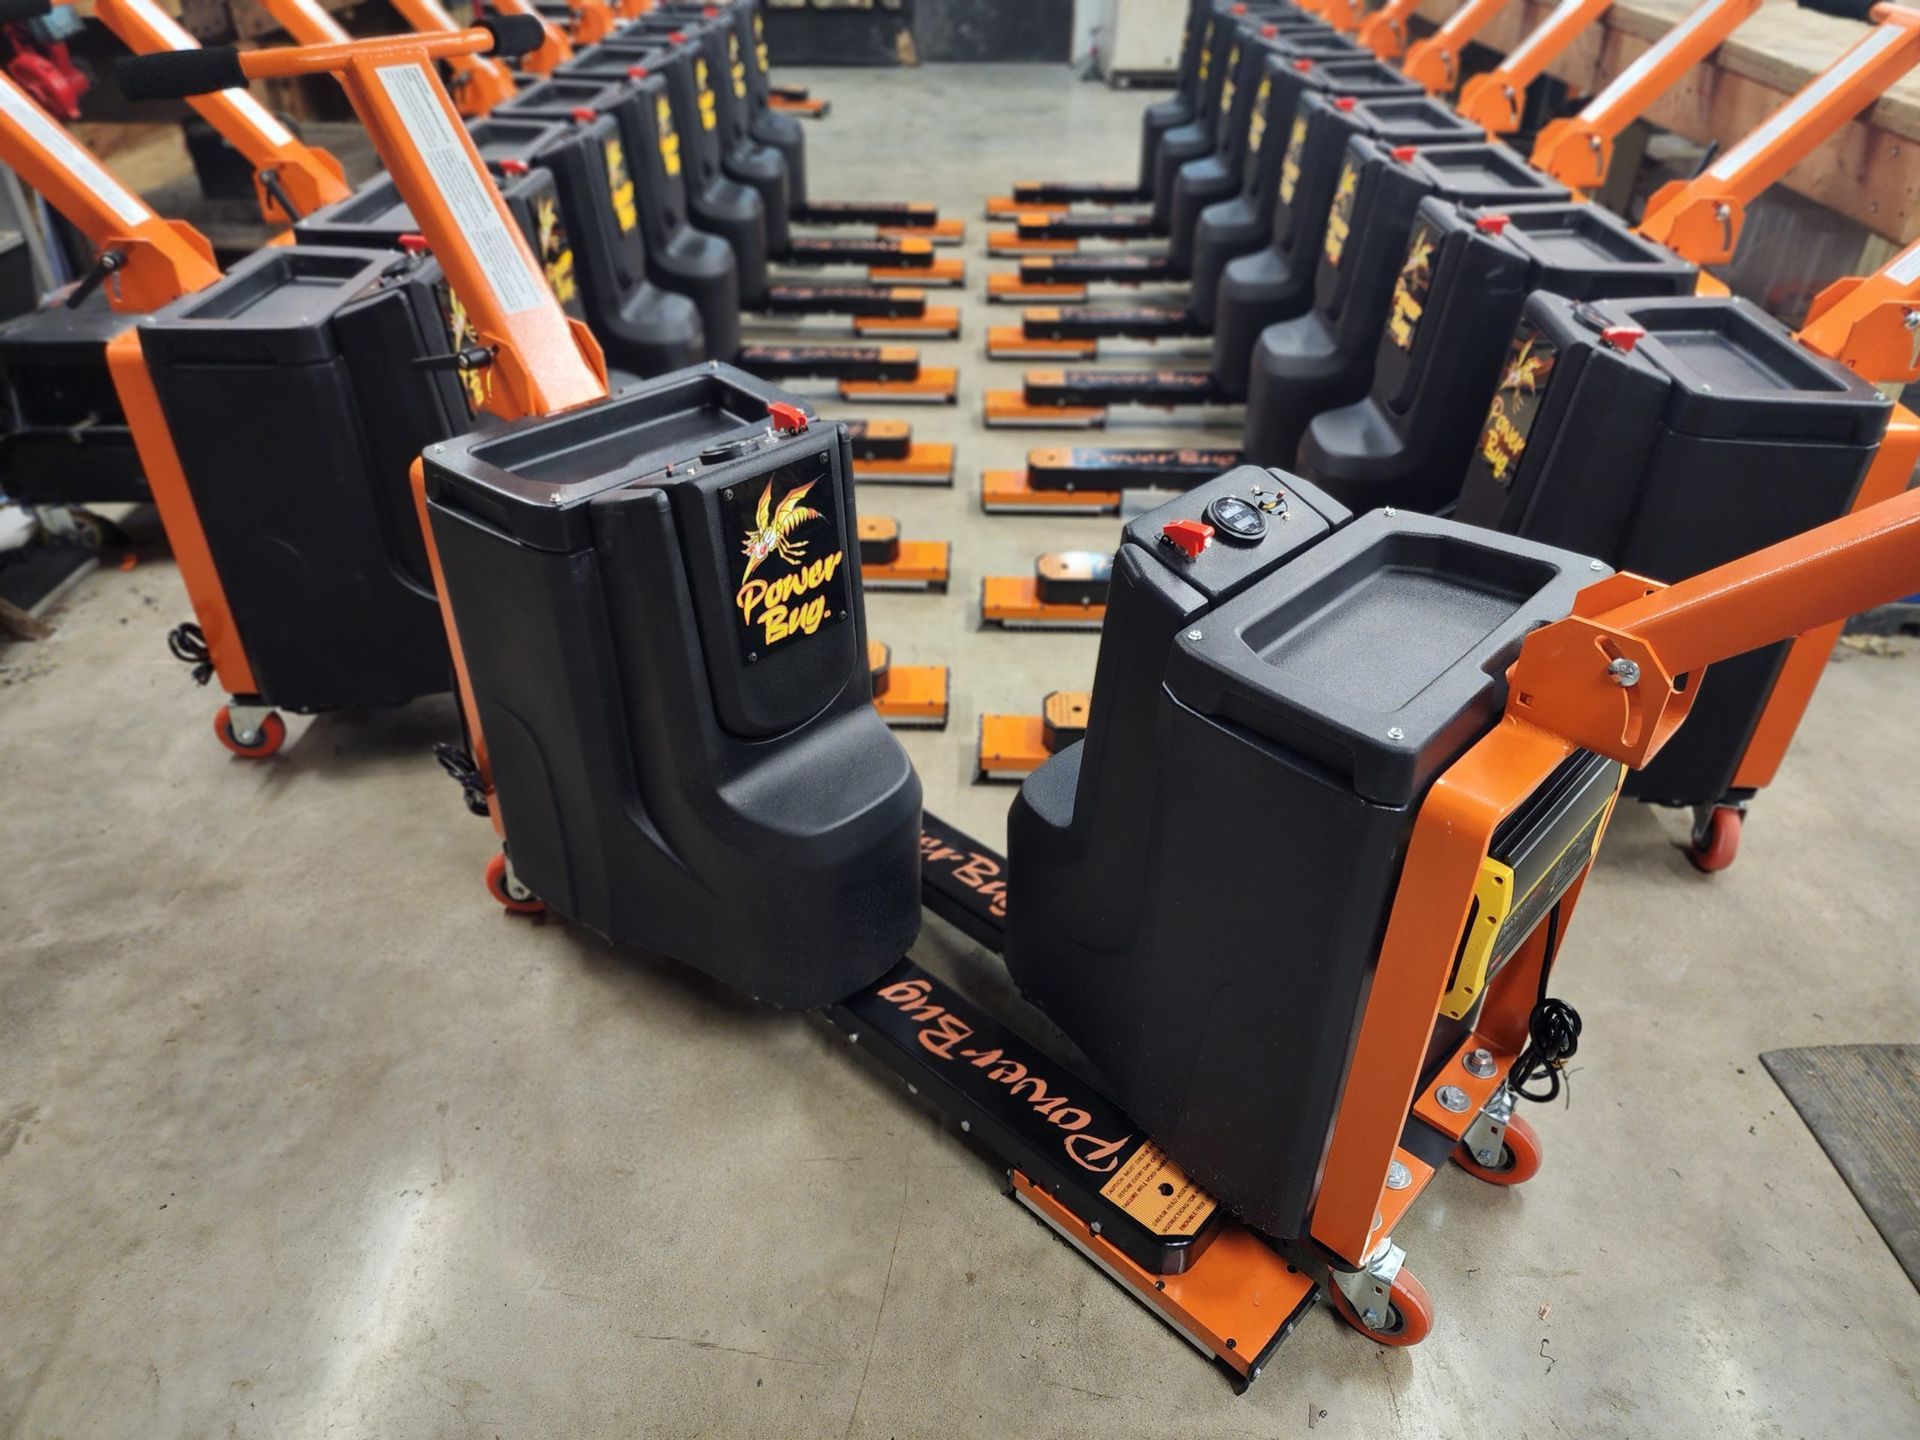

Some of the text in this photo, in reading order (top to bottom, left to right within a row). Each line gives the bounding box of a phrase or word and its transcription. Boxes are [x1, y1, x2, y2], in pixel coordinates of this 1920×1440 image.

[1490, 394, 1526, 455] Power
[736, 550, 842, 626] Power
[757, 594, 831, 646] Bug.
[877, 979, 1133, 1173] Power Bug
